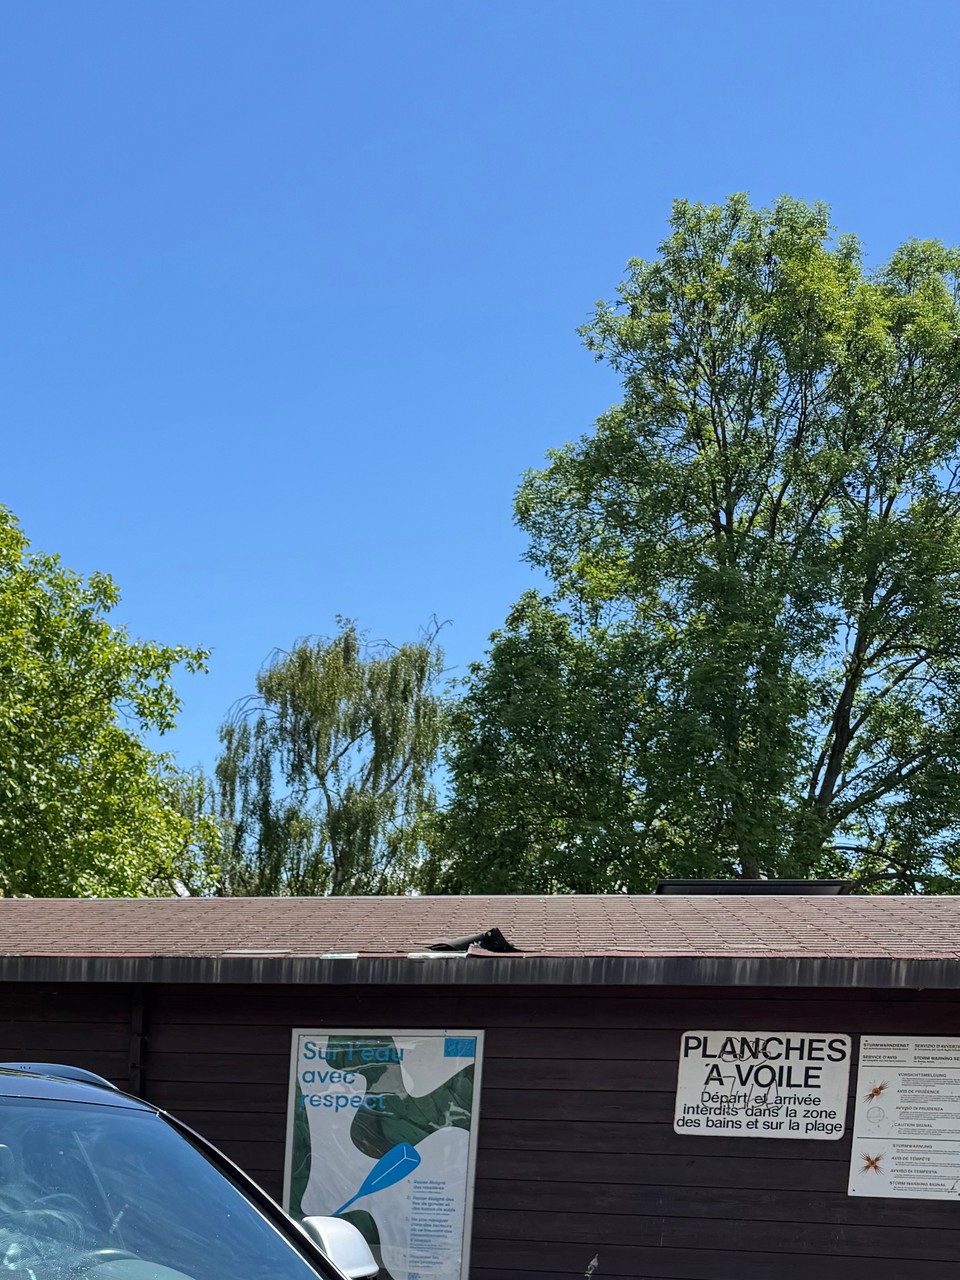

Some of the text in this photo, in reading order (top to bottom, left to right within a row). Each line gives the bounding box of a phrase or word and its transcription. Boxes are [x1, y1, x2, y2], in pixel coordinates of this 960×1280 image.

[303, 1041, 339, 1060] Sur
[683, 1035, 847, 1062] PLANCHES
[301, 1069, 356, 1085] avec
[735, 1063, 823, 1089] VOILE
[300, 1093, 386, 1113] respect
[701, 1091, 821, 1108] Départ et arrivée
[683, 1104, 837, 1120] interdits dans la zone
[676, 1116, 843, 1134] des bains et sur la plage
